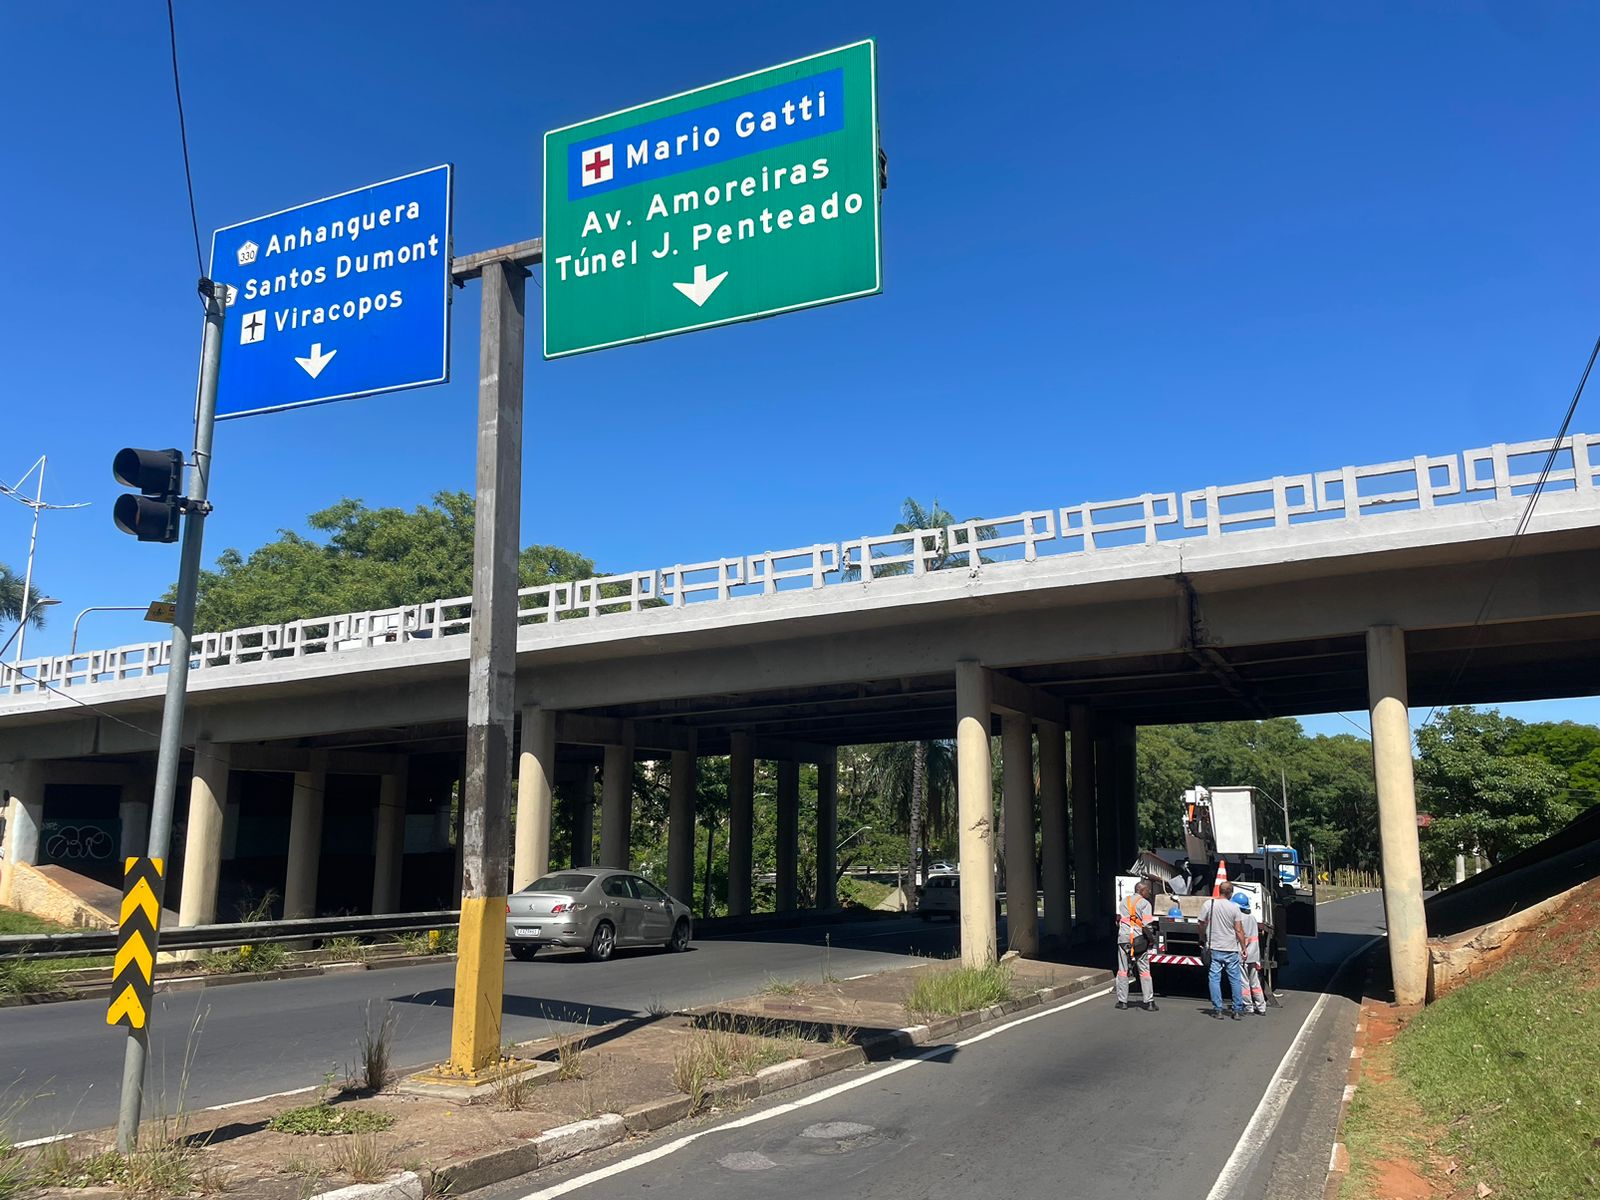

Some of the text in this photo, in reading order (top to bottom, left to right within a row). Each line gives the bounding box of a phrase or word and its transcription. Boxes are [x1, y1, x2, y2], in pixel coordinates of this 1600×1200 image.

[627, 91, 826, 169] Mario Gatti
[265, 201, 420, 257] Anhanguera
[581, 157, 830, 238] Av. Amoreiras
[240, 250, 255, 262] 330
[244, 233, 439, 300] Santos Dumont
[555, 191, 863, 281] Túnel J. Penteado
[274, 290, 403, 332] Viracopos
